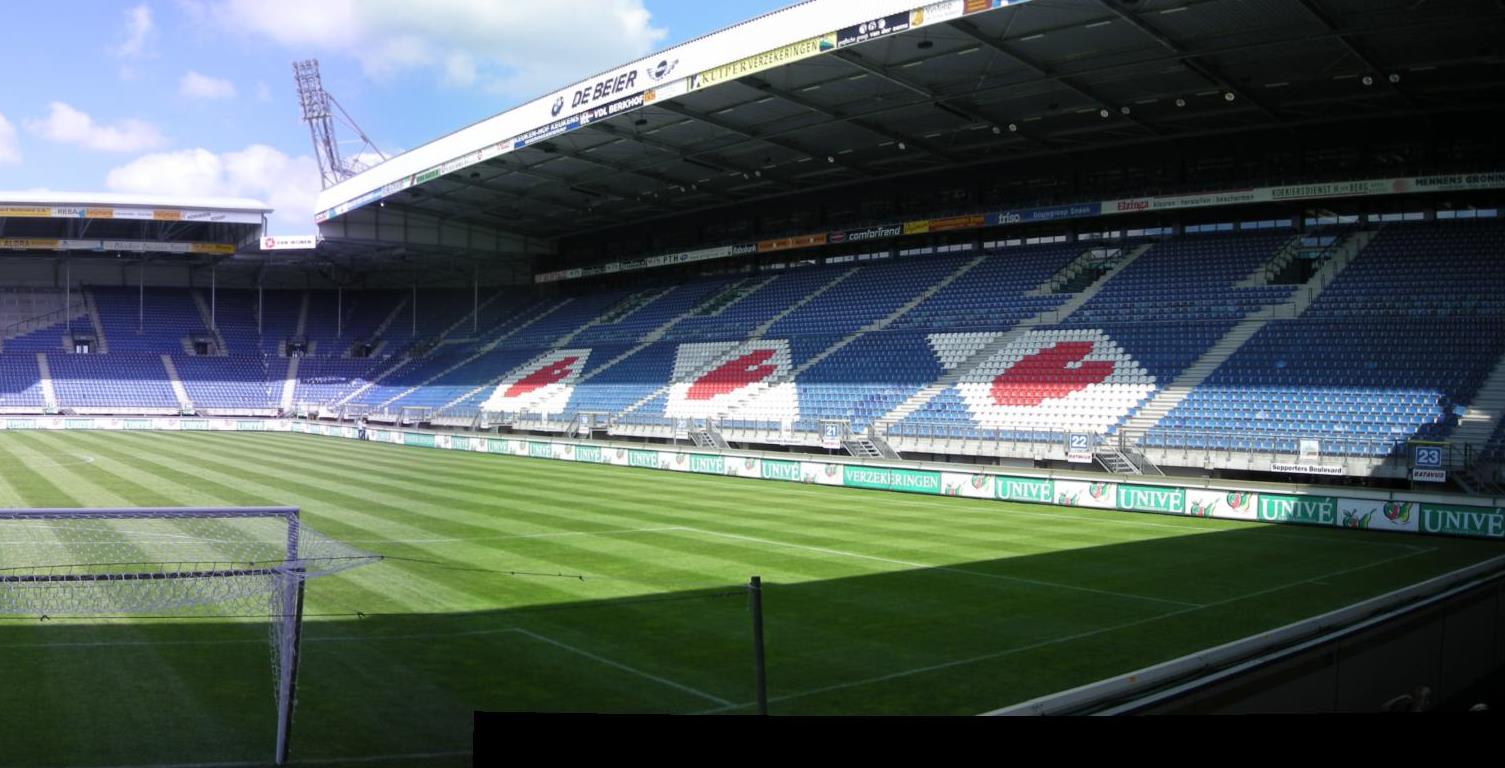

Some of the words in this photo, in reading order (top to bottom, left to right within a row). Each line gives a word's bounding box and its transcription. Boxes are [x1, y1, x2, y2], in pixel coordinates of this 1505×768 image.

[702, 61, 746, 83] KUIPER
[748, 40, 818, 69] VERZEKERINGEN
[572, 86, 592, 108] DE
[592, 69, 638, 101] BEIER
[594, 107, 608, 119] VDL
[608, 95, 644, 114] BERKHOF
[1415, 176, 1463, 186] MENNENS
[998, 211, 1021, 224] friso
[826, 426, 836, 437] 21
[1071, 435, 1088, 448] 22
[629, 451, 657, 467] UNIVÉ
[691, 456, 724, 473] UNIVÉ
[1417, 449, 1439, 464] 23
[762, 461, 800, 480] UNIVÉ
[847, 469, 938, 488] VERZEKERINGEN
[1272, 464, 1308, 473] Supporters
[1309, 466, 1342, 474] Boulevard
[997, 478, 1052, 503] UNIVÉ
[1119, 487, 1184, 513] UNIVÉ
[1260, 497, 1334, 525] UNIVÉ
[1424, 508, 1505, 537] UNIVÉ
